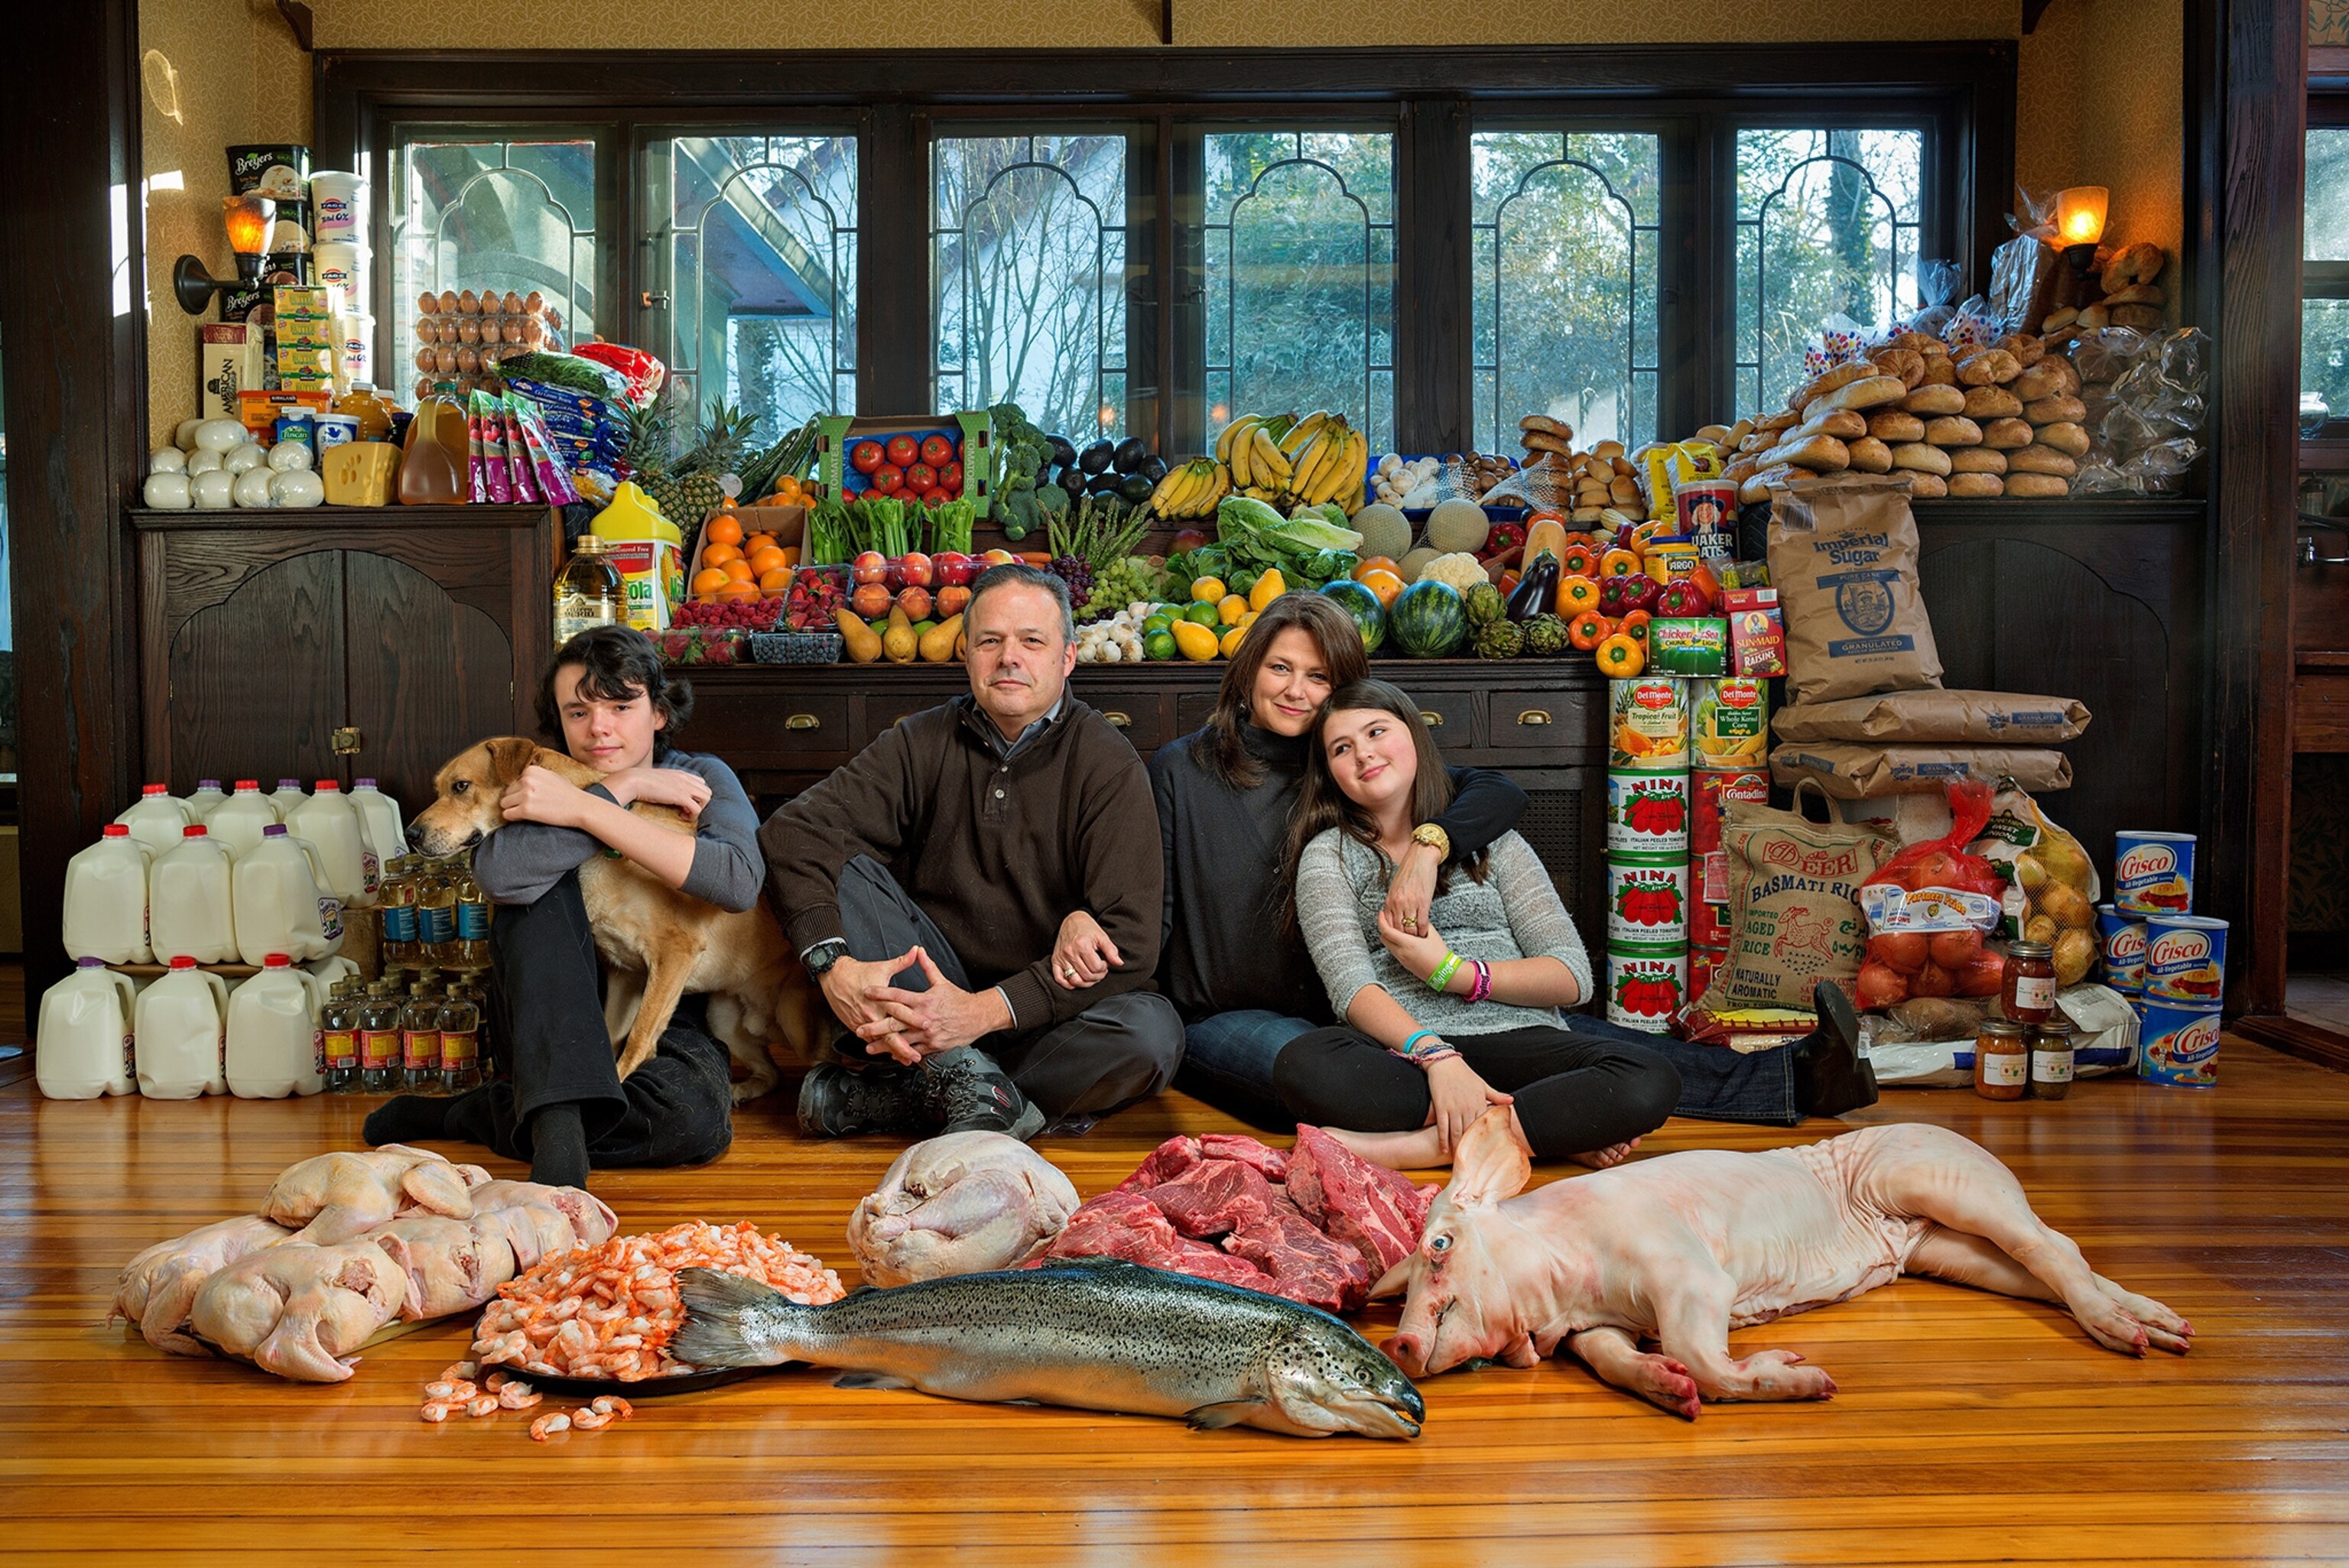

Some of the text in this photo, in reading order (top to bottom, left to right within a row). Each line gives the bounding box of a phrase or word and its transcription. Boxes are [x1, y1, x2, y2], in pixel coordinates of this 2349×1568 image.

[235, 152, 273, 176] Breyers
[225, 291, 260, 313] Breyers
[221, 359, 235, 415] AMERICAN
[283, 429, 308, 439] Tuscan
[830, 443, 840, 492] TOMATES
[966, 437, 976, 491] TOMATOES
[1691, 534, 1733, 547] UAKER
[1813, 532, 1889, 552] Imperial
[1698, 545, 1725, 559] ATS
[1829, 550, 1880, 566] Sugar
[1669, 560, 1694, 570] ARGO
[1658, 628, 1692, 640] Chicken
[1705, 630, 1719, 639] Sea
[1841, 640, 1903, 651] GRANULATED
[1744, 650, 1776, 667] RAISINS
[1649, 691, 1672, 700] Monte
[1735, 690, 1756, 699] Monte
[1632, 713, 1660, 721] Tropical
[1890, 766, 1915, 774] Imperial
[1631, 778, 1683, 794] NINA
[1727, 788, 1767, 800] Contadina
[1989, 829, 2018, 842] NIONS
[2121, 855, 2169, 881] Crisco
[1623, 870, 1677, 885] NINA
[2124, 875, 2159, 888] All-Vegetable
[1752, 875, 1862, 907] BASMATI RIC
[1906, 891, 1967, 915] Partners Pride
[1749, 909, 1779, 919] IMPORTED
[1745, 920, 1776, 937] AGED
[1741, 940, 1771, 956] RICE
[2113, 933, 2146, 958] Cris
[2152, 941, 2204, 966] Crisco
[1623, 961, 1676, 975] NINA
[2156, 962, 2192, 975] All-Vegetable
[1736, 967, 1781, 987] NATURALLY
[1731, 982, 1778, 1000] AROMATIC
